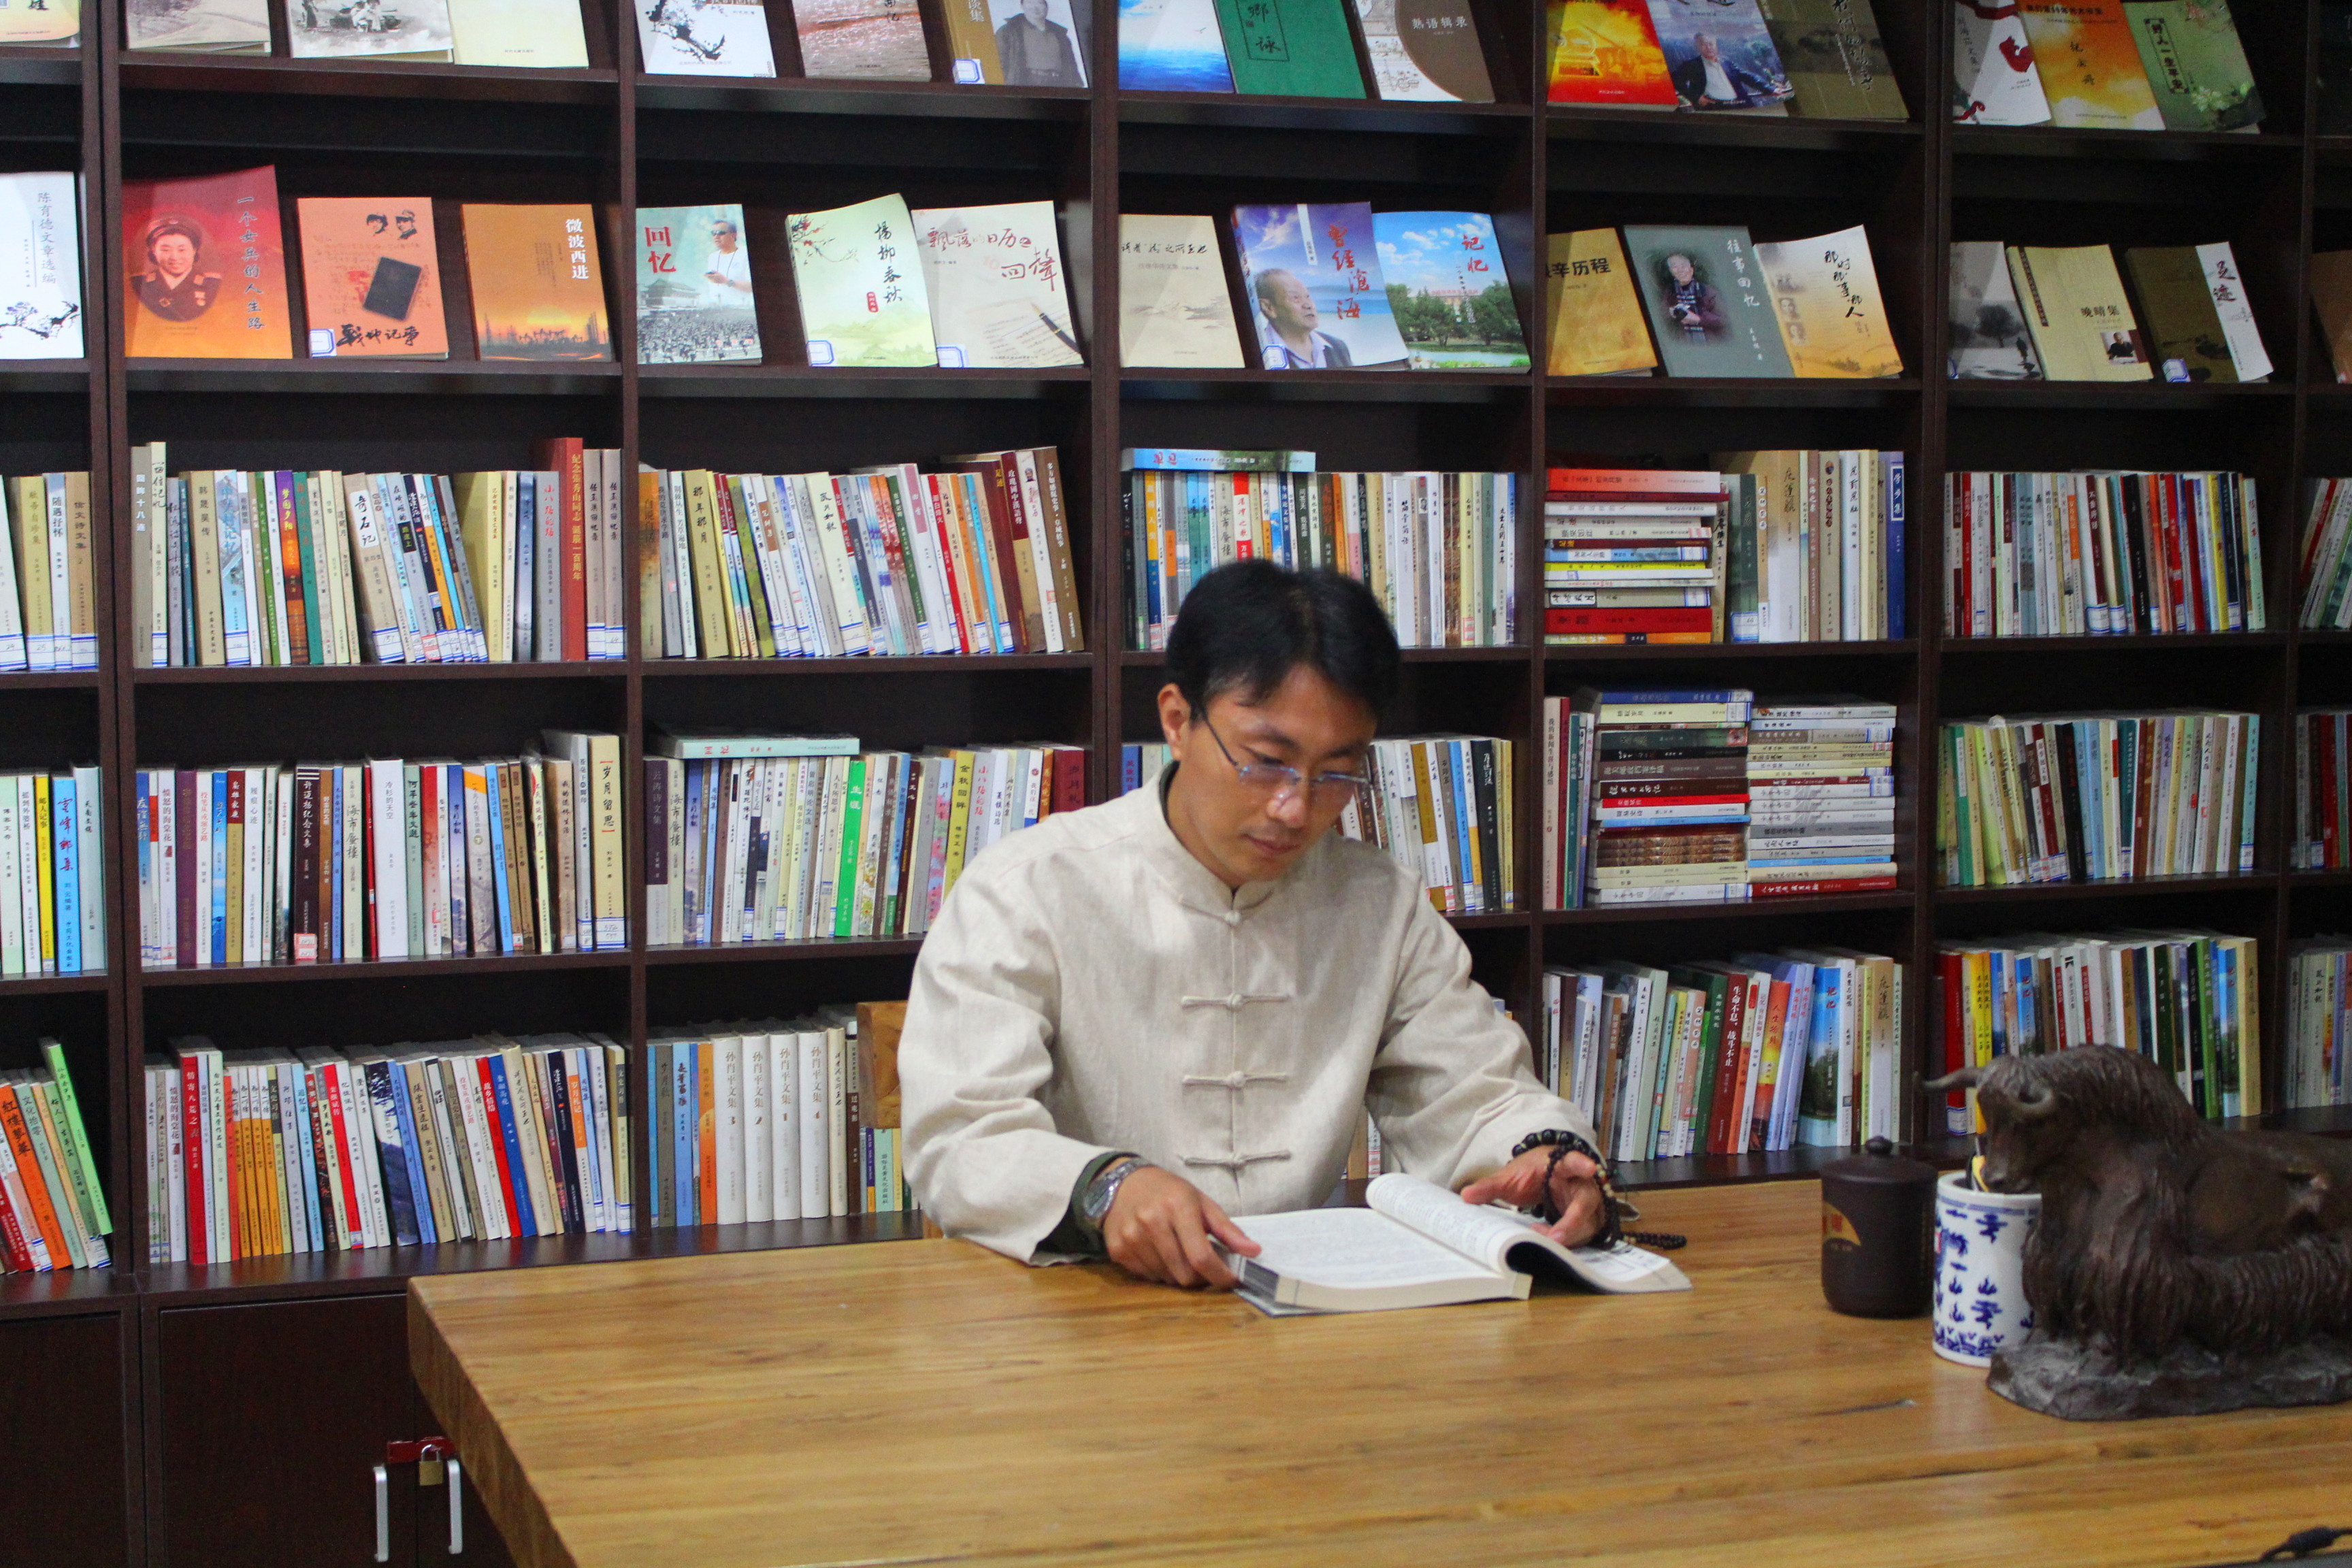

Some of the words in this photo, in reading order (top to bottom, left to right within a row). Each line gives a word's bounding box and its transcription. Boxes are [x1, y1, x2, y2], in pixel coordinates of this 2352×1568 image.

[238, 195, 265, 330] 一个女兵的人生路
[565, 219, 589, 280] 微波西进
[644, 227, 676, 274] 回忆
[1461, 234, 1488, 273] 记忆
[1727, 240, 1760, 308] 往事回忆
[355, 495, 376, 546] 奇石记
[693, 486, 708, 543] 那年那月
[956, 765, 970, 808] 金秋回眸
[346, 804, 360, 860] 海市蜃楼
